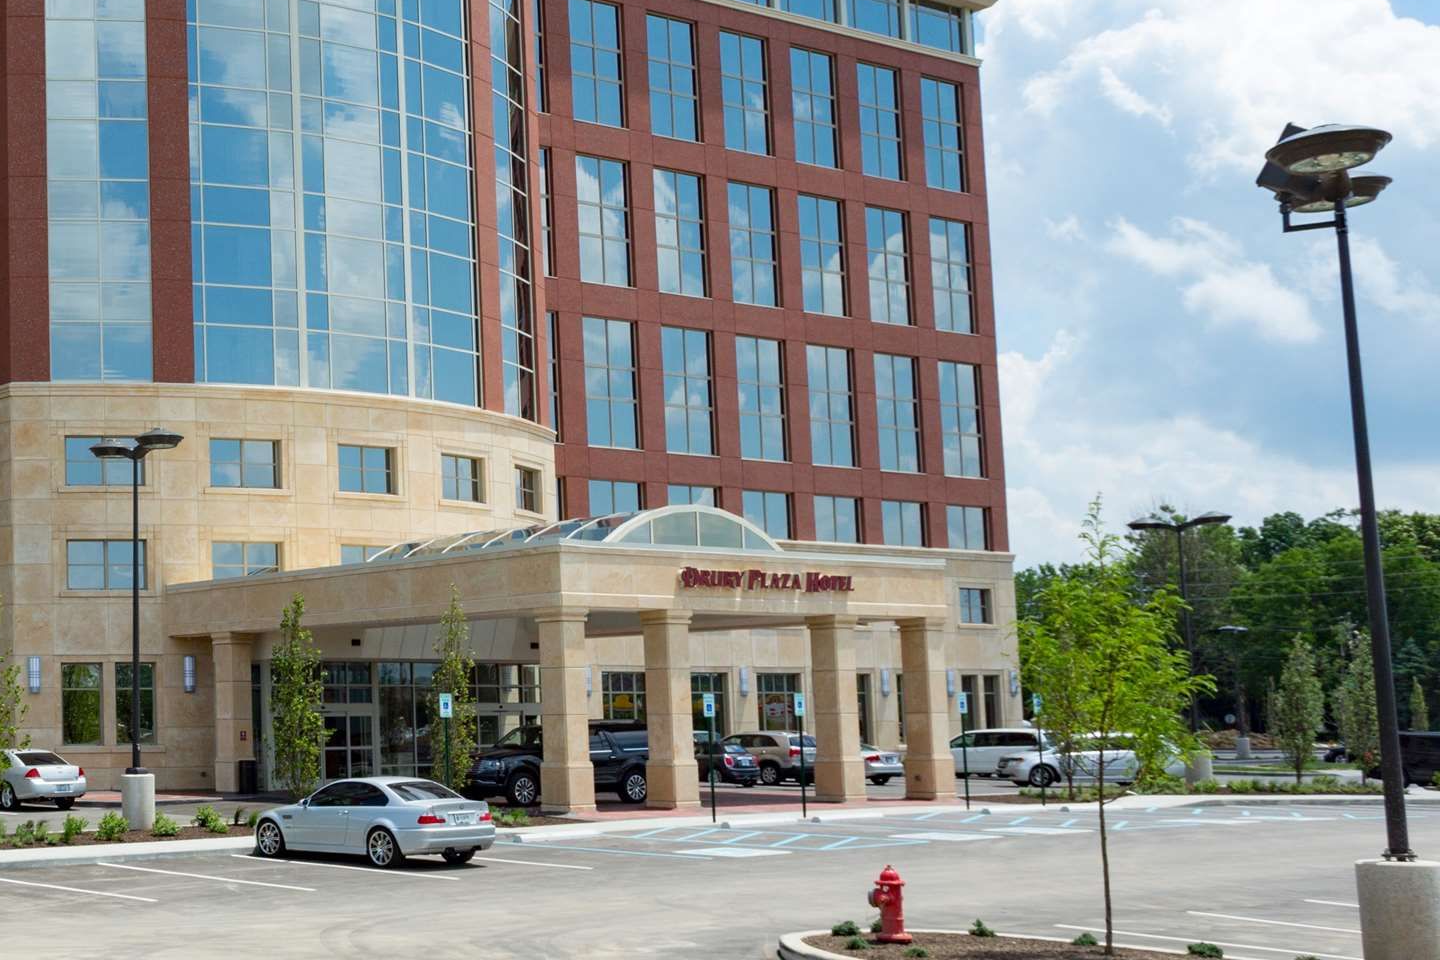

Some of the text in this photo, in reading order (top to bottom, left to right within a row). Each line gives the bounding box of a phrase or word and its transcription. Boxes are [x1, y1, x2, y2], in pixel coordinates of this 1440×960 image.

[681, 567, 855, 592] DRURY PLAZA HOTEL
